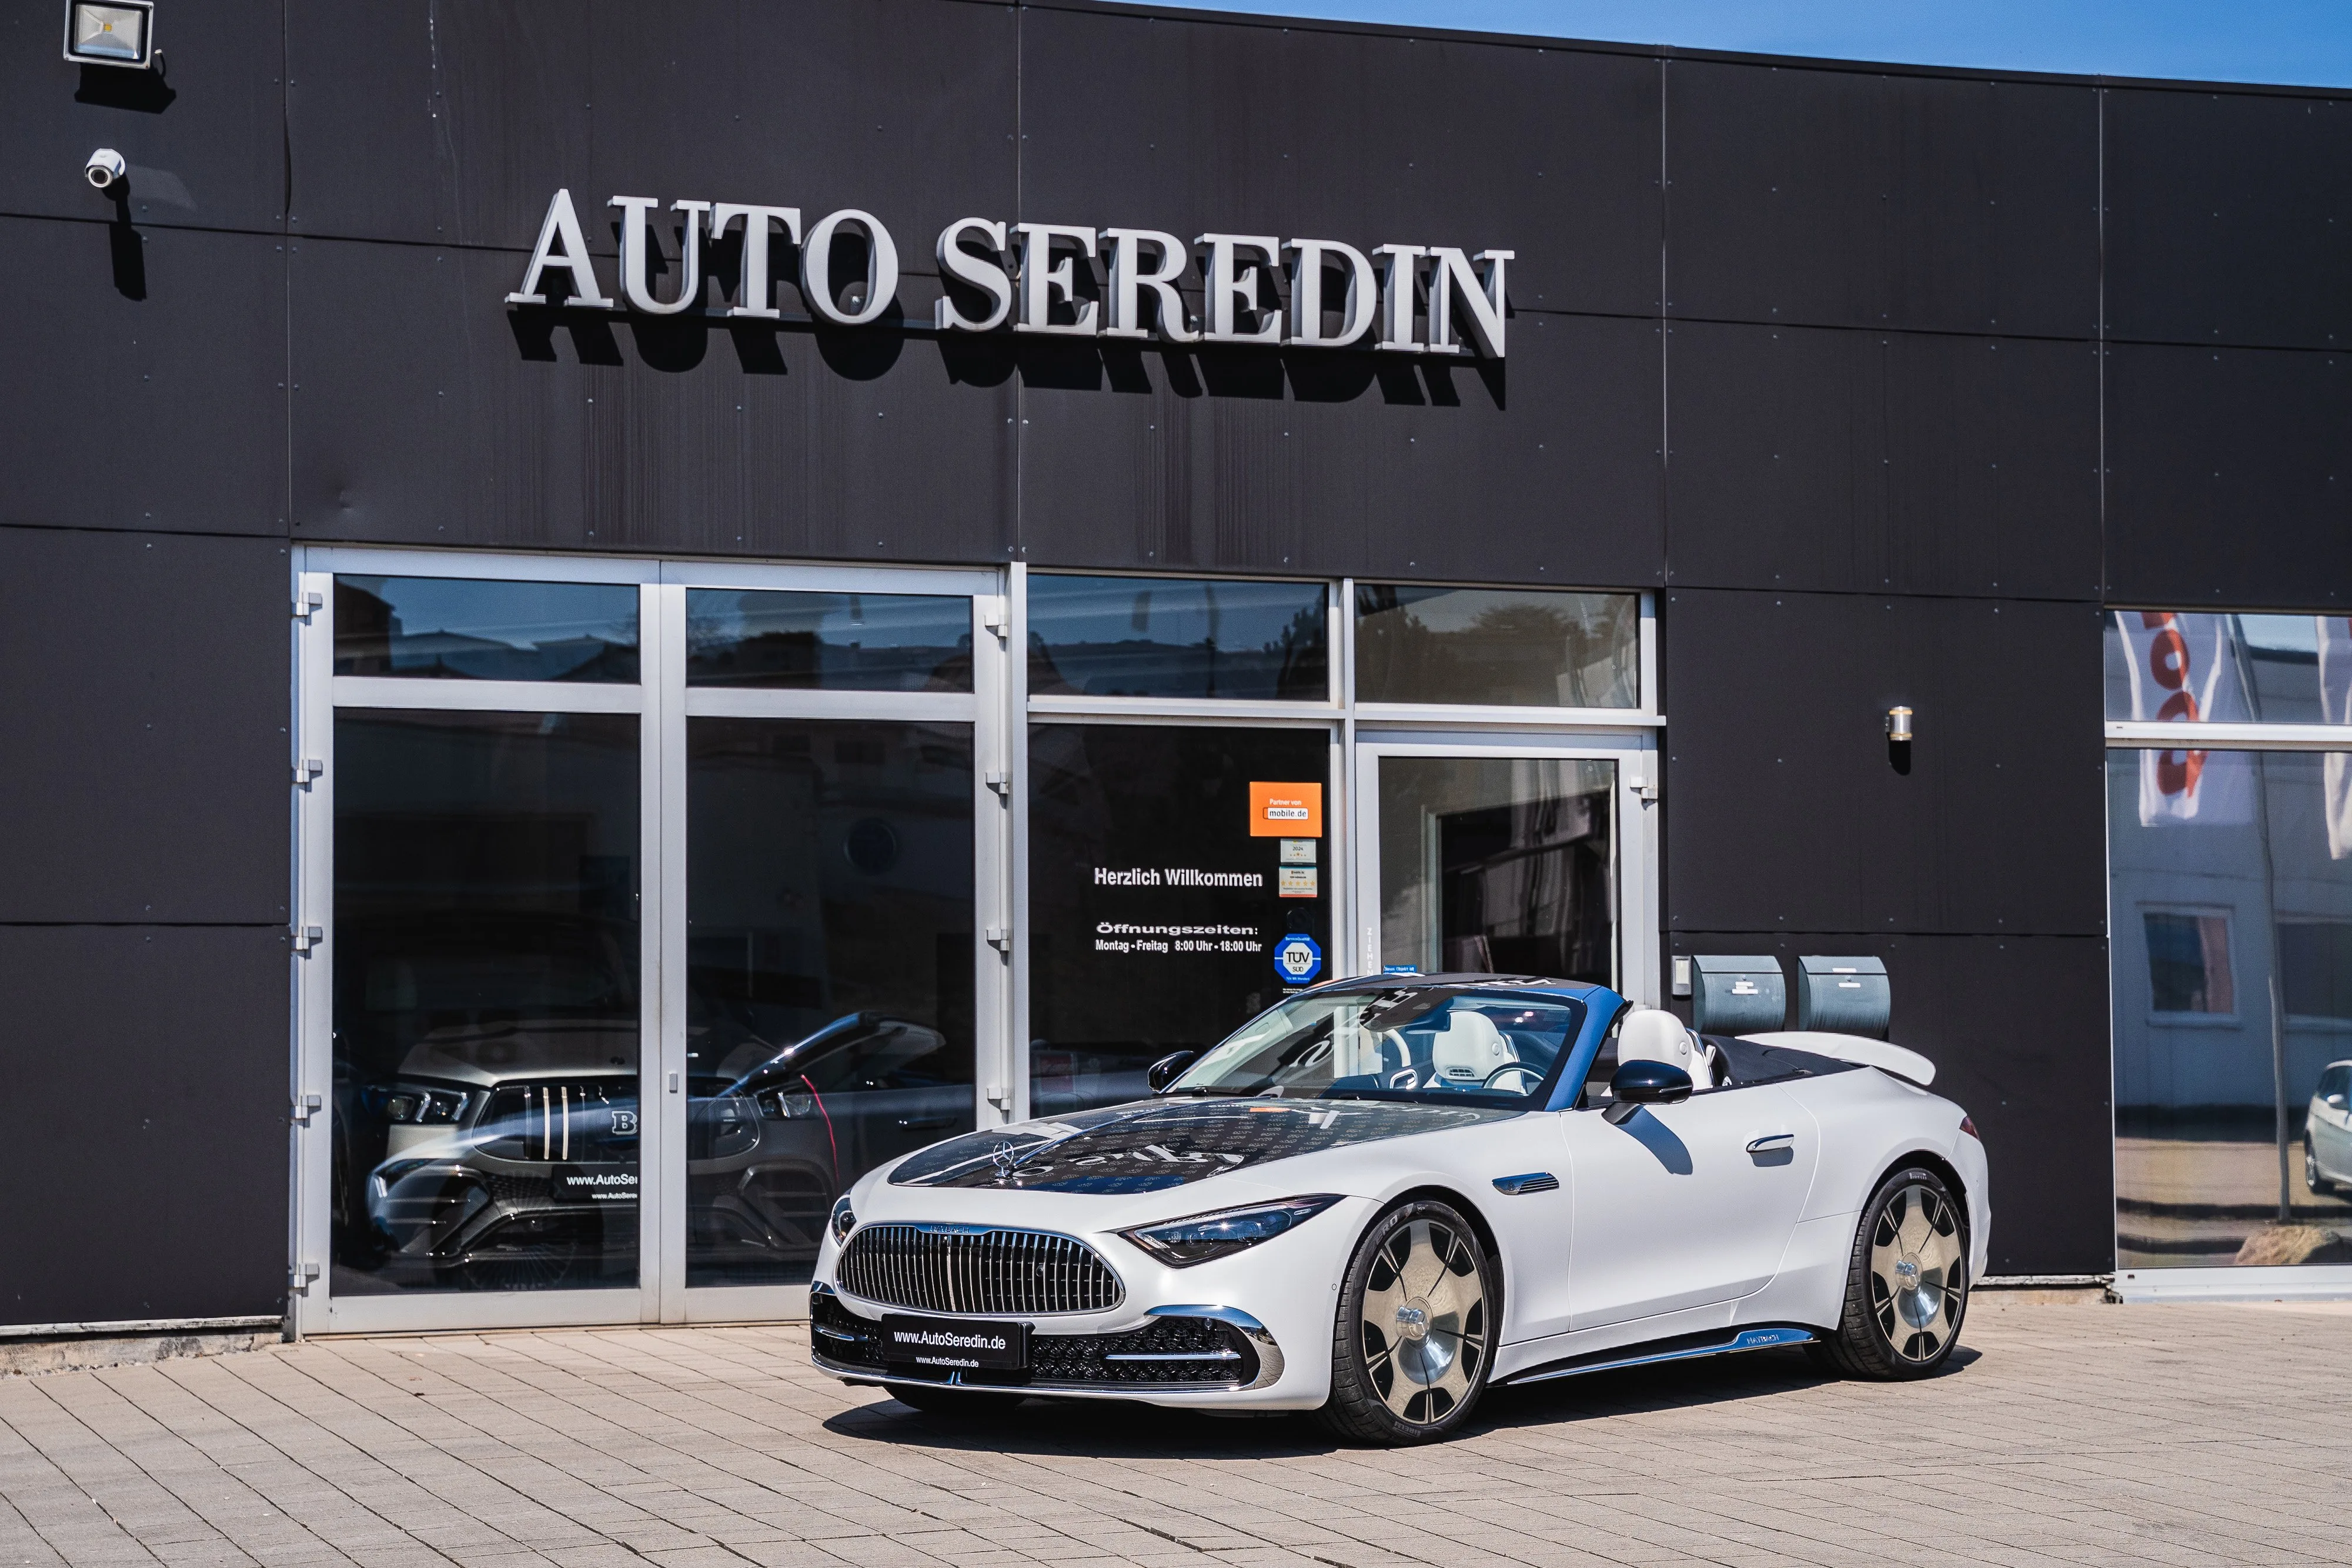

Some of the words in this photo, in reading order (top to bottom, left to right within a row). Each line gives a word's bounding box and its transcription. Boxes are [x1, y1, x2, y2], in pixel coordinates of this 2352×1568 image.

[505, 188, 900, 326] AUTO
[935, 216, 1516, 359] SEREDIN
[1269, 798, 1290, 806] Partner
[1094, 867, 1160, 885] Herzlich
[1164, 868, 1263, 887] Willkommen
[1096, 921, 1258, 937] Öffnungszeiten:
[1095, 939, 1130, 954] Montag
[1136, 939, 1168, 954] Freitag
[1174, 940, 1195, 951] 8:00
[1195, 940, 1213, 952] Uhr
[1220, 940, 1244, 952] 18:00
[1245, 941, 1263, 952] Uhr
[1286, 951, 1309, 963] TÜV
[894, 1330, 1006, 1350] www.AutoSeredin.de
[1746, 1334, 1779, 1345] MAYBACH
[916, 1356, 979, 1368] www.AutoSeredin.de
